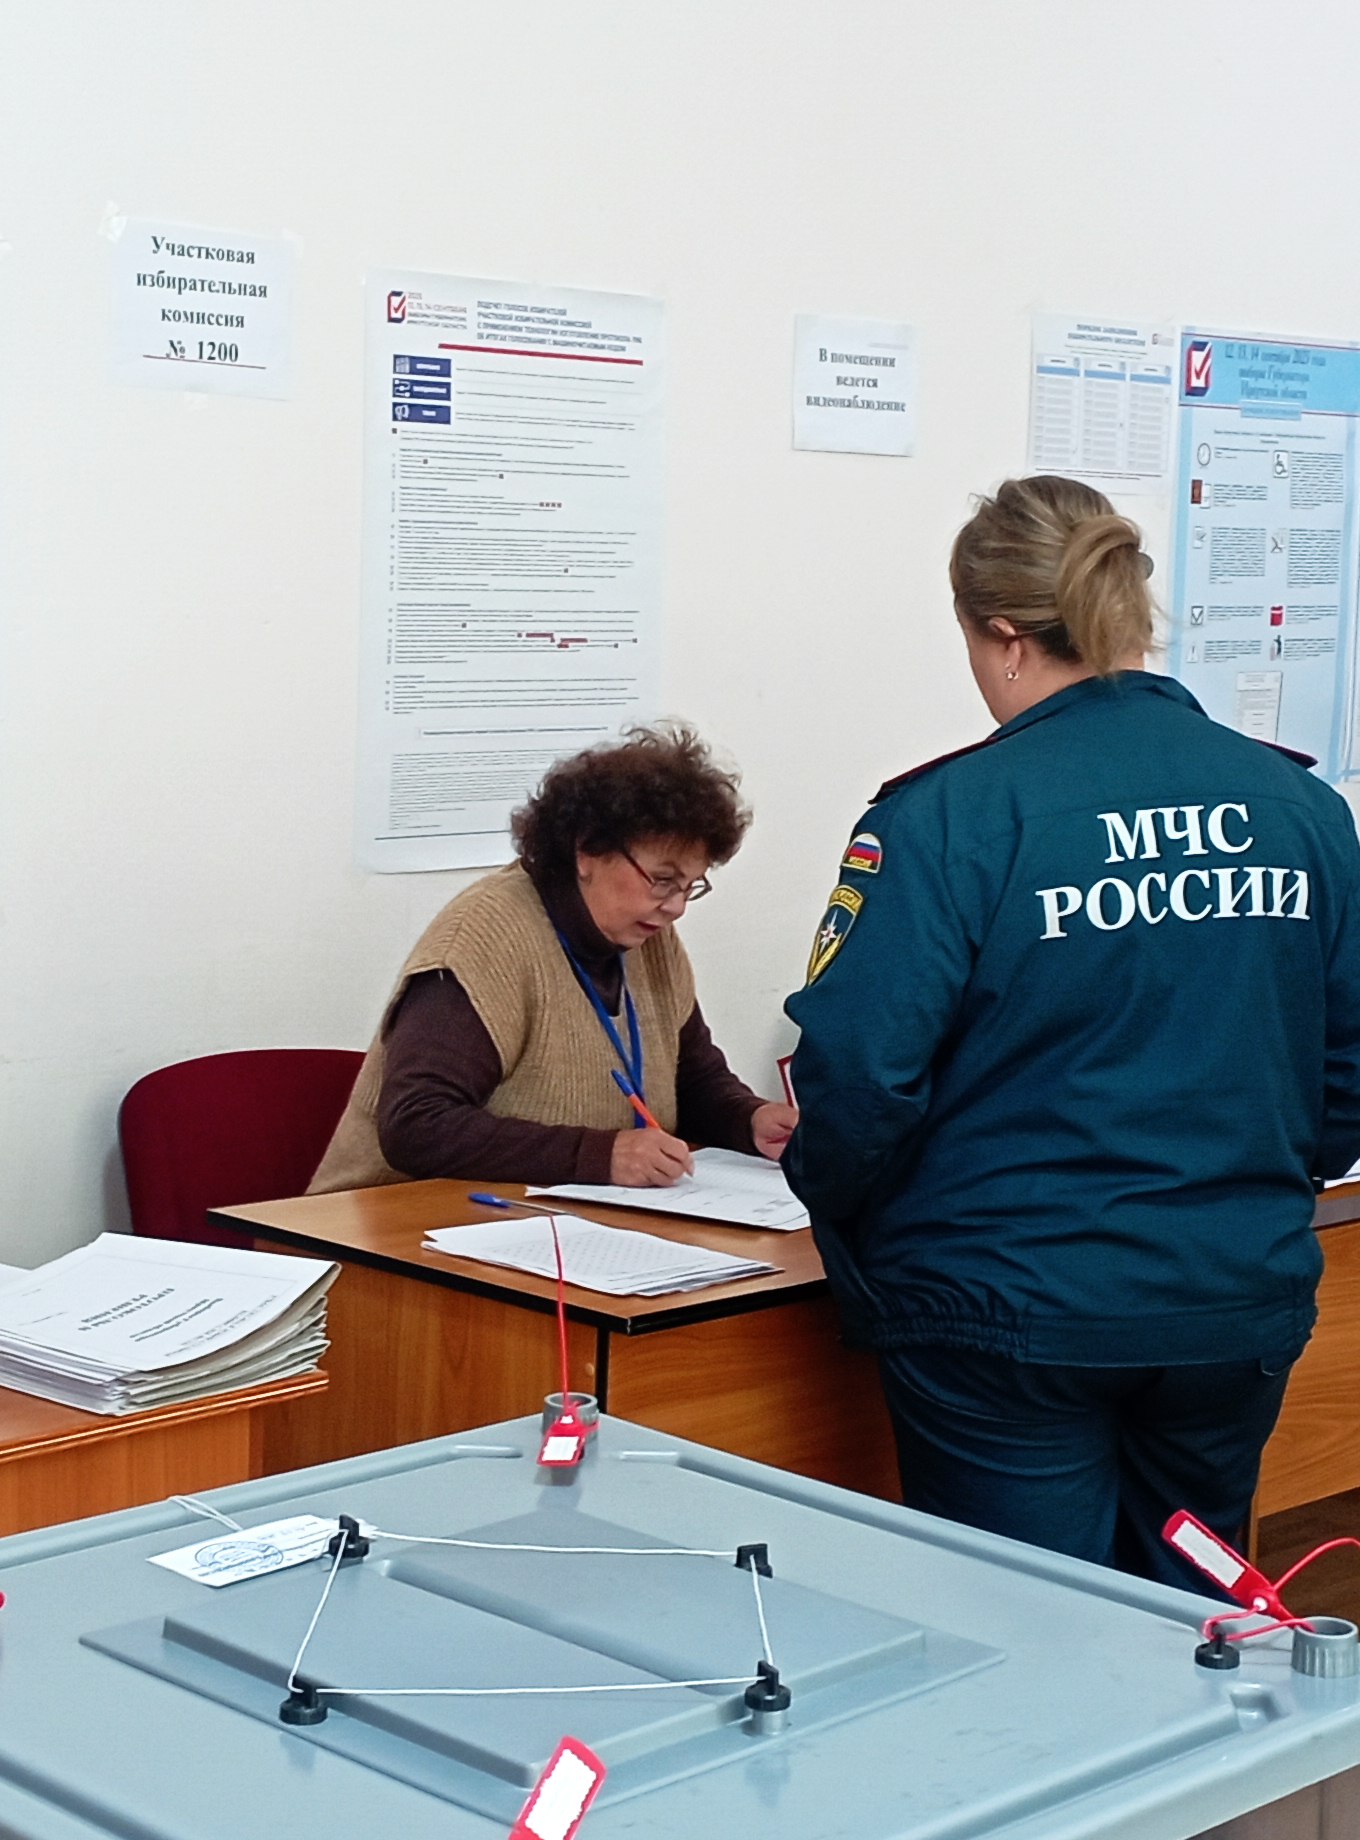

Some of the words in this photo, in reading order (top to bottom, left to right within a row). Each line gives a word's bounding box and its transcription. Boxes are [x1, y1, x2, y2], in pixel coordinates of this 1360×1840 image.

[151, 235, 256, 264] Участковая
[136, 270, 268, 298] избирательная
[160, 308, 246, 329] комиссия
[166, 339, 186, 359] №
[197, 341, 239, 362] 1200
[819, 348, 828, 362] В
[805, 395, 906, 412] видеонаблюдение
[1097, 803, 1254, 863] МЧС
[1035, 866, 1311, 940] РОССИИ
